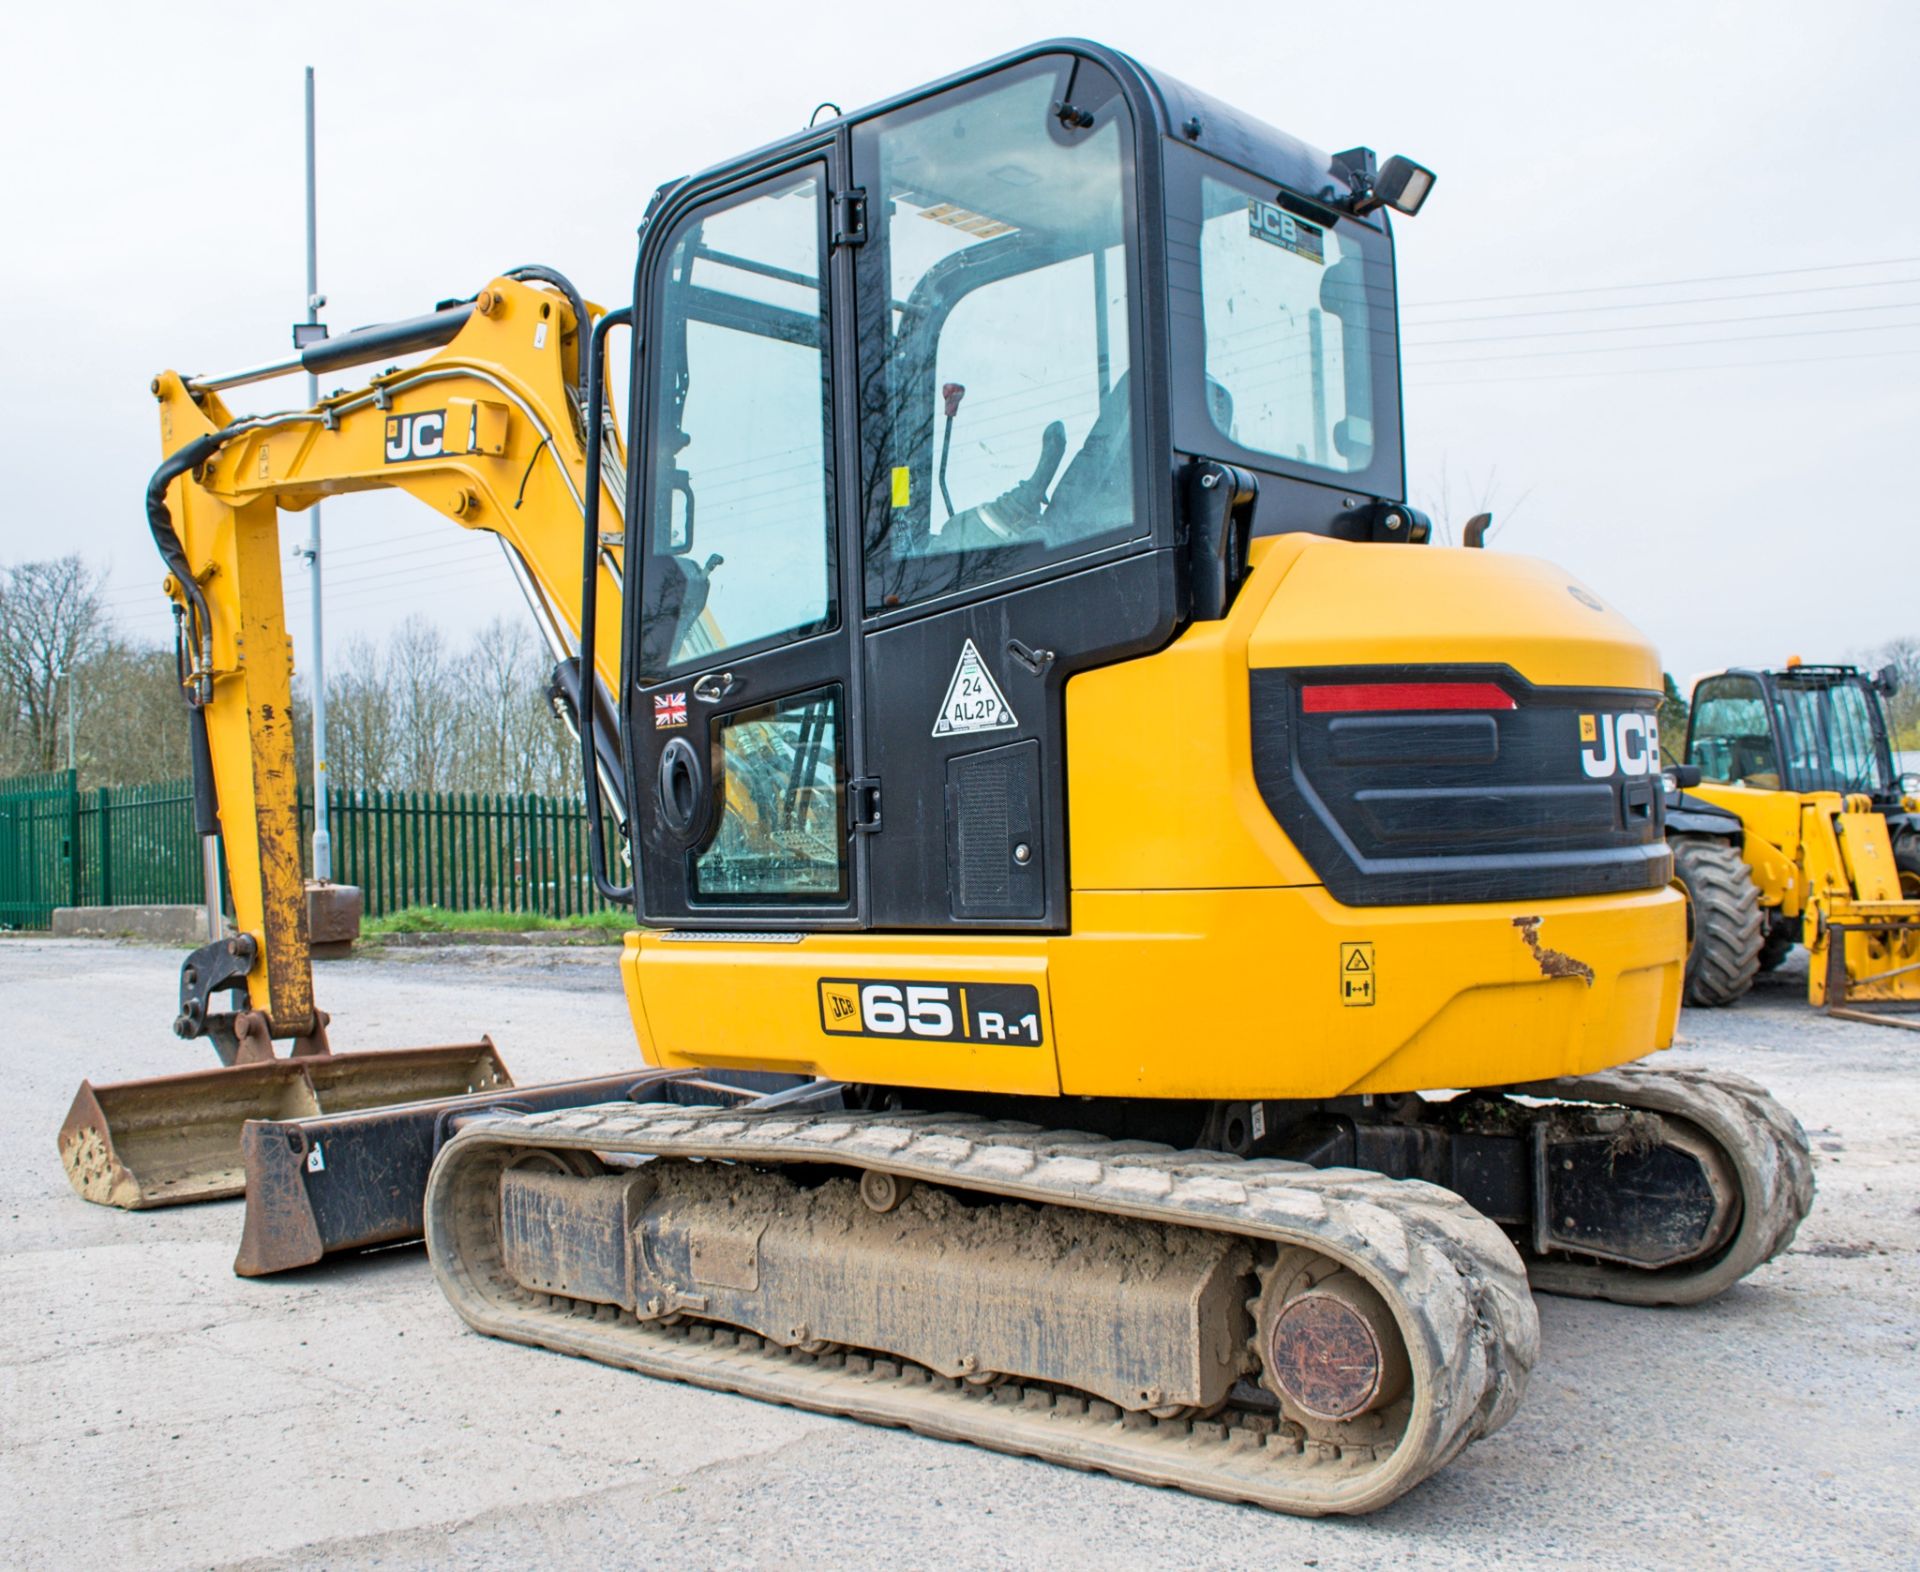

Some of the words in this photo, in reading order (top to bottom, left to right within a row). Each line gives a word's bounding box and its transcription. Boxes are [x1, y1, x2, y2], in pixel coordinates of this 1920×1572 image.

[1250, 203, 1297, 243] JCB
[386, 413, 475, 460] JC
[962, 677, 982, 696] 24
[954, 699, 995, 721] AL2P
[1582, 713, 1661, 778] JCB
[832, 996, 854, 1018] JCB
[861, 985, 954, 1037] 65
[978, 1012, 1039, 1041] R-1
